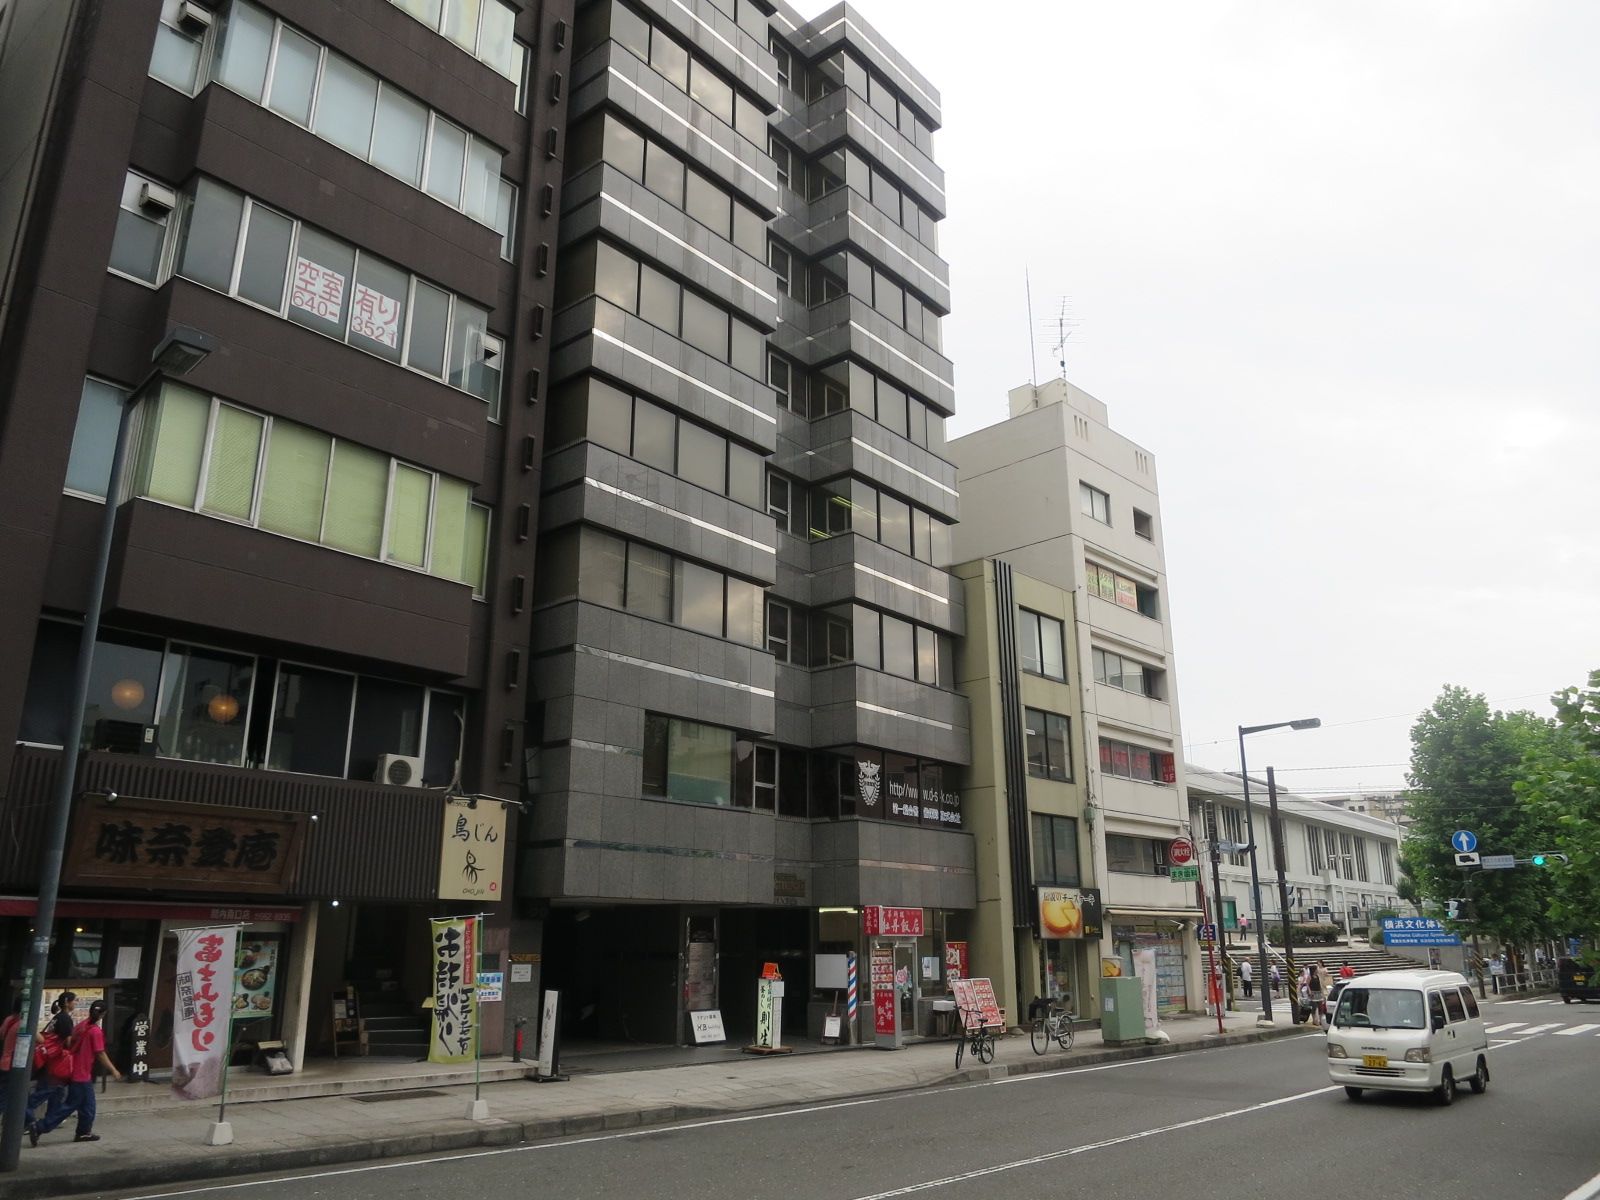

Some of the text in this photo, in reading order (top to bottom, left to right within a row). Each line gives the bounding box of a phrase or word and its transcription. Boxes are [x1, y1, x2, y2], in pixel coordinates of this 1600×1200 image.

[295, 261, 398, 326] 空室 有り
[352, 315, 397, 347] 3521
[1173, 847, 1191, 857] 消火栓
[132, 1020, 150, 1076] 営業中
